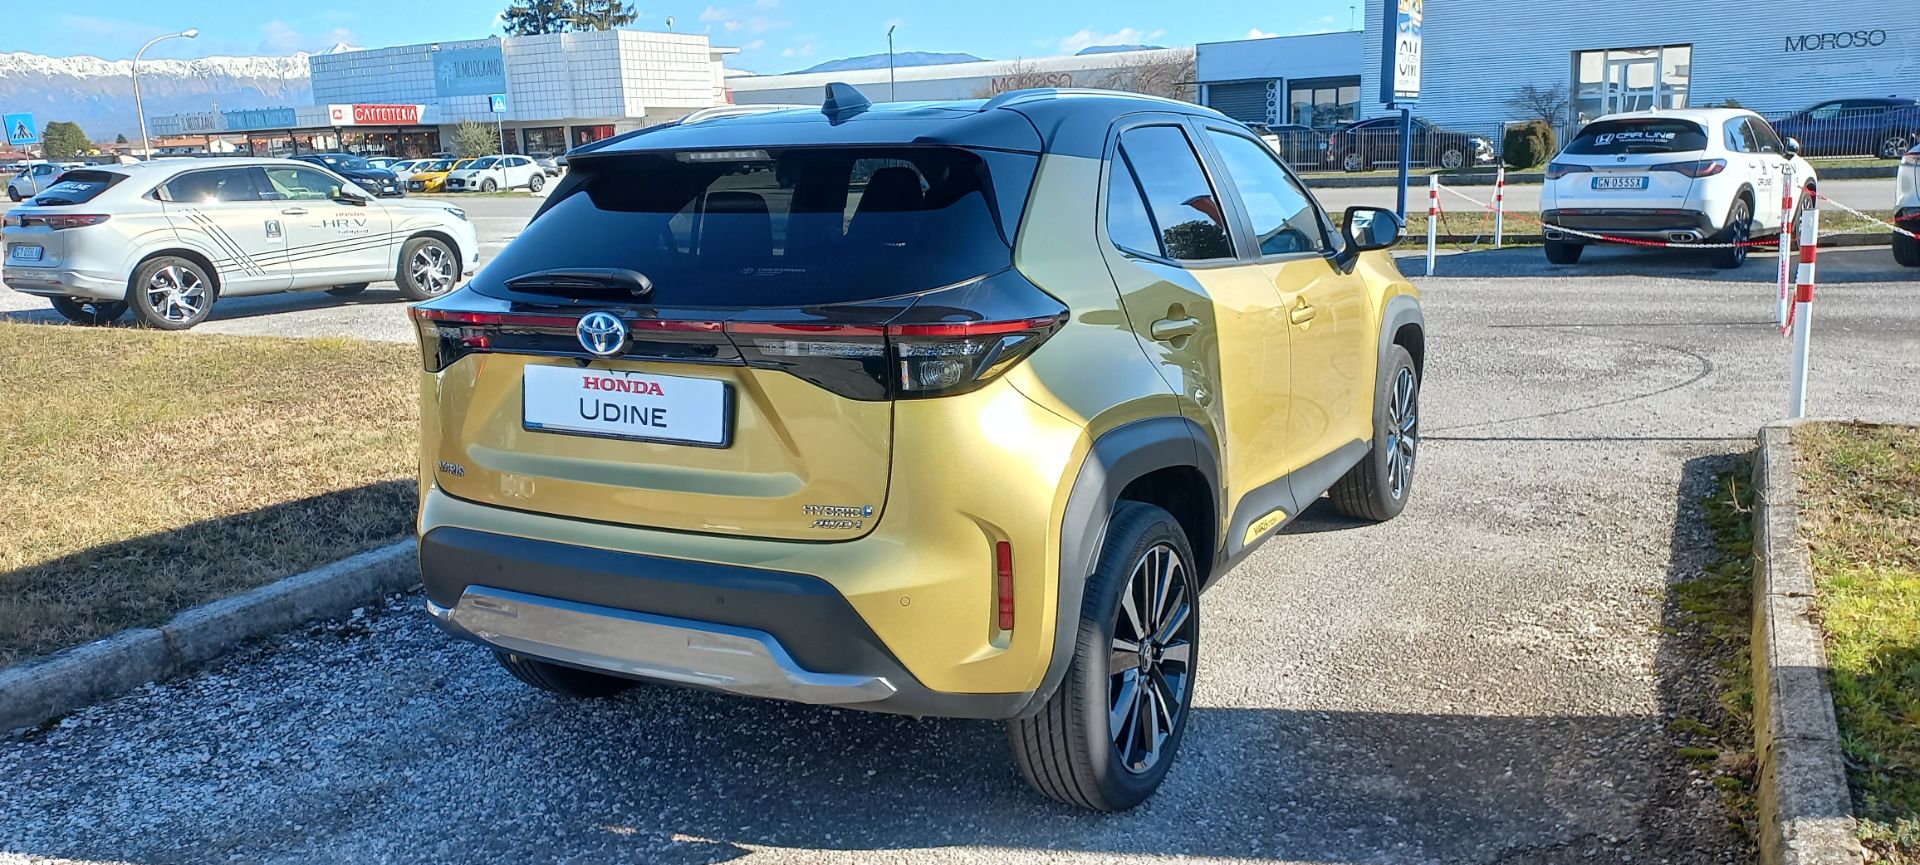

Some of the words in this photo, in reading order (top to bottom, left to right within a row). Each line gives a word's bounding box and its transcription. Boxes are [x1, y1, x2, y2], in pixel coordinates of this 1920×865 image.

[1784, 29, 1887, 52] MOROSO
[1266, 80, 1277, 125] OROSO
[354, 107, 418, 121] CAFFETTERIA
[582, 376, 664, 396] HONDA
[579, 397, 667, 428] UDINE
[802, 504, 862, 518] HYBRID
